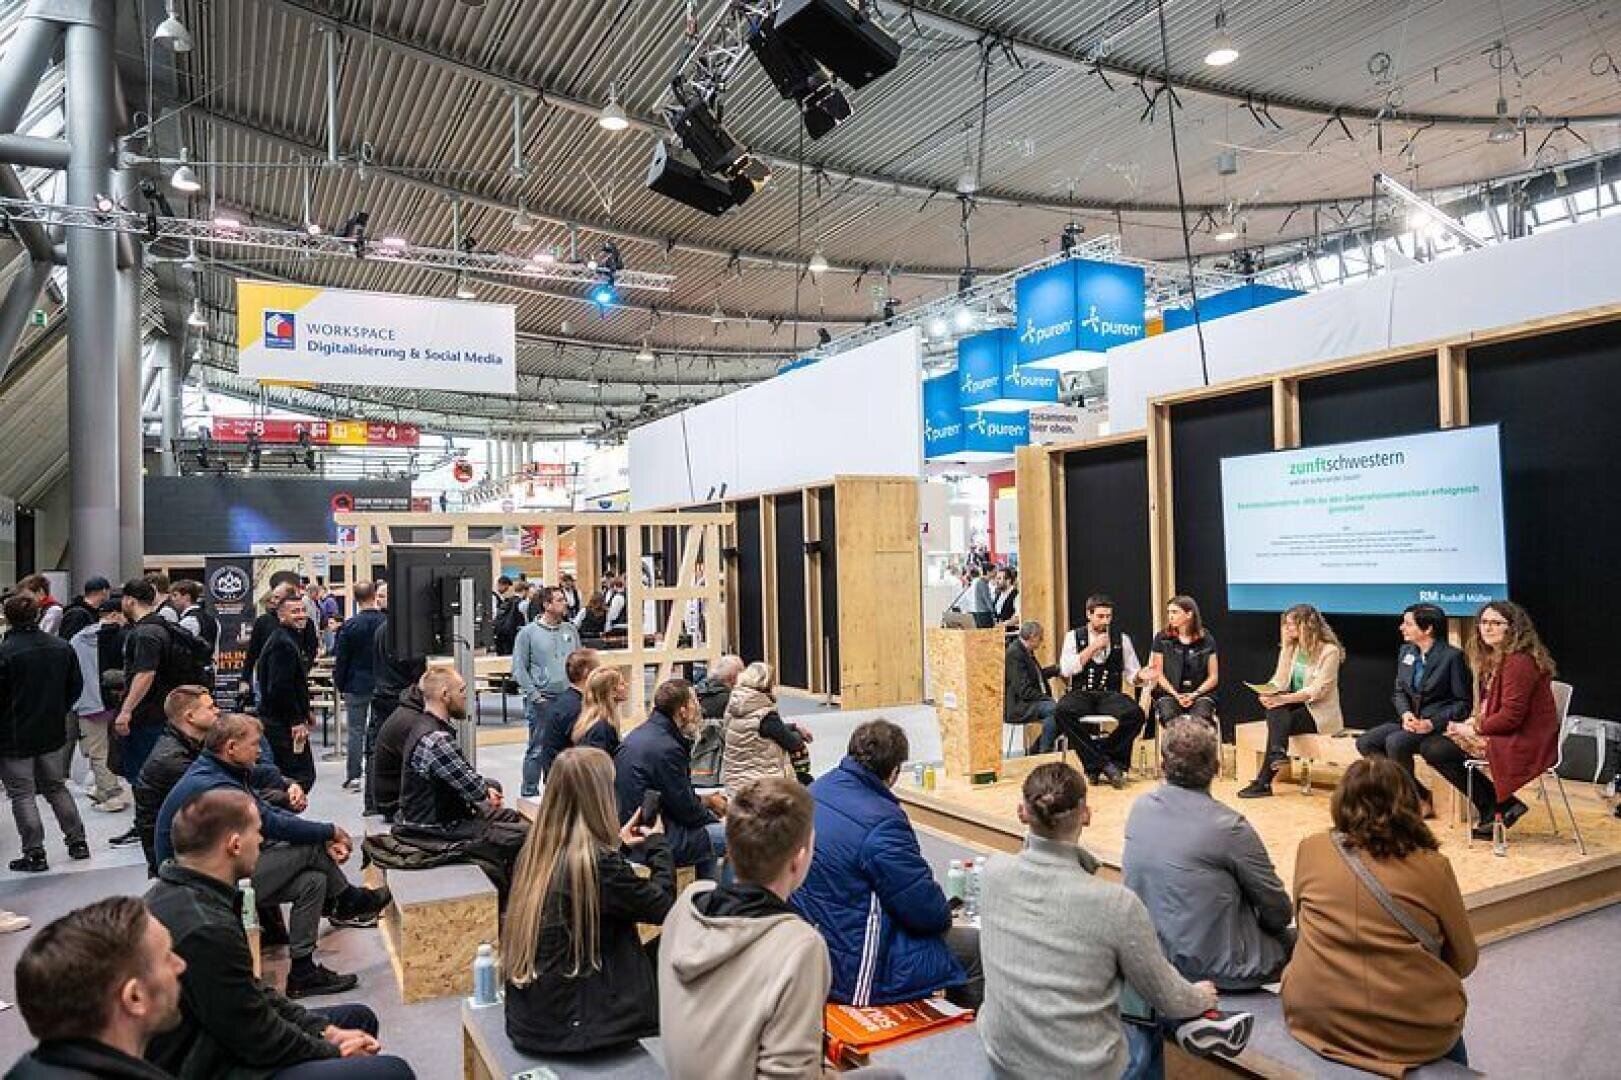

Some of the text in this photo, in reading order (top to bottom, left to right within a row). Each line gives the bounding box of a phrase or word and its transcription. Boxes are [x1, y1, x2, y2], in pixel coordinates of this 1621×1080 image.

[306, 323, 396, 341] WORKSPACE
[1036, 322, 1070, 344] puren
[1101, 321, 1139, 337] puren
[306, 340, 503, 365] Digitalisierung & Social Media
[971, 375, 998, 392] puren
[1020, 373, 1053, 389] puren
[386, 425, 398, 441] 4
[932, 424, 959, 442] puren
[987, 422, 1024, 437] puren
[1289, 451, 1405, 475] zunftschwestern
